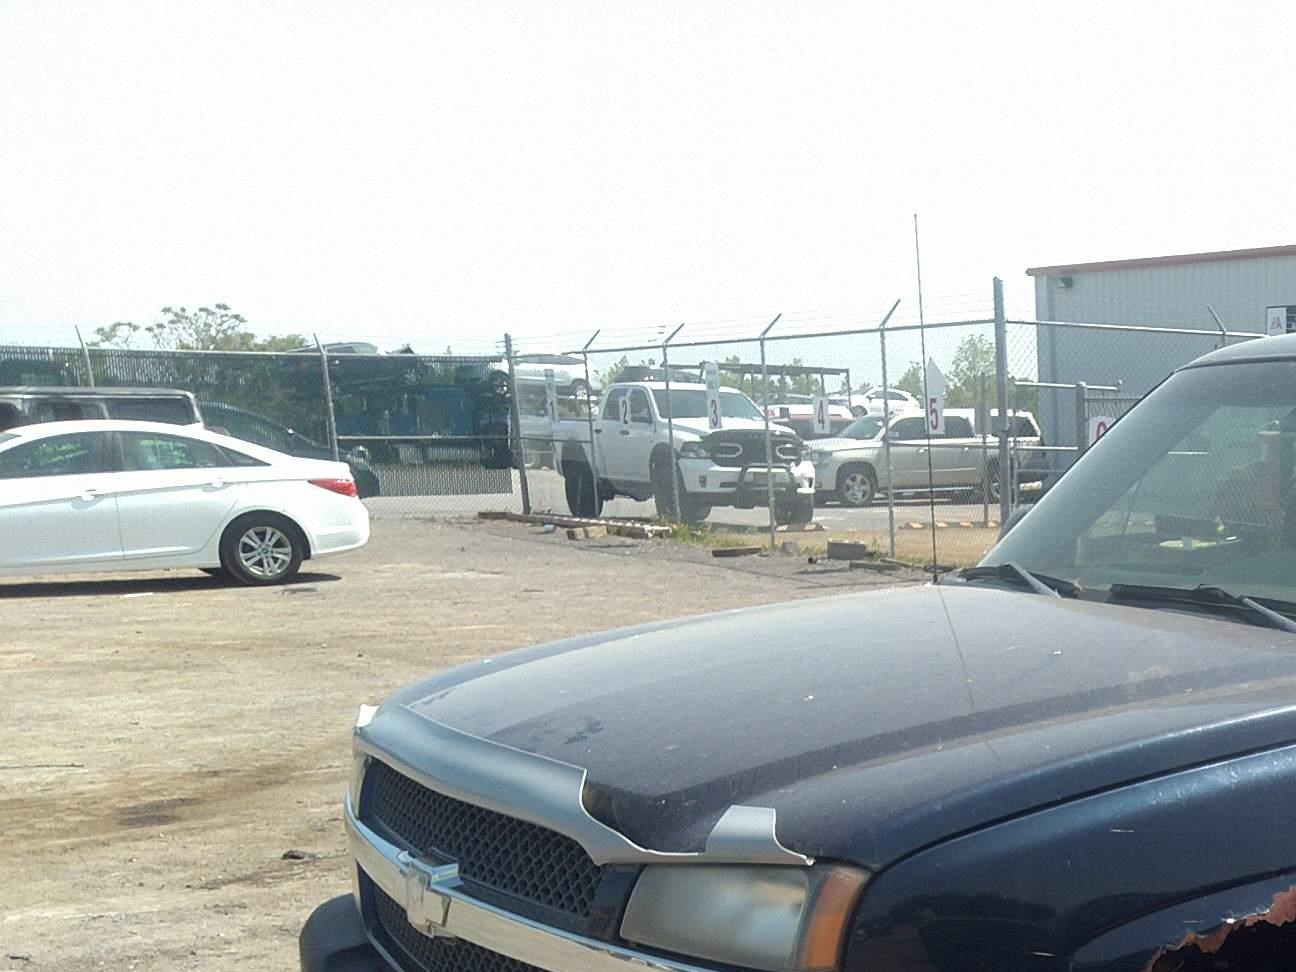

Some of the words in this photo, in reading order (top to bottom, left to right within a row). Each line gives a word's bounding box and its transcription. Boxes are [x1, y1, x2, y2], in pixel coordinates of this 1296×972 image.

[621, 399, 629, 425] 2
[710, 399, 719, 427] 3
[817, 400, 826, 431] 4
[929, 398, 940, 431] 5
